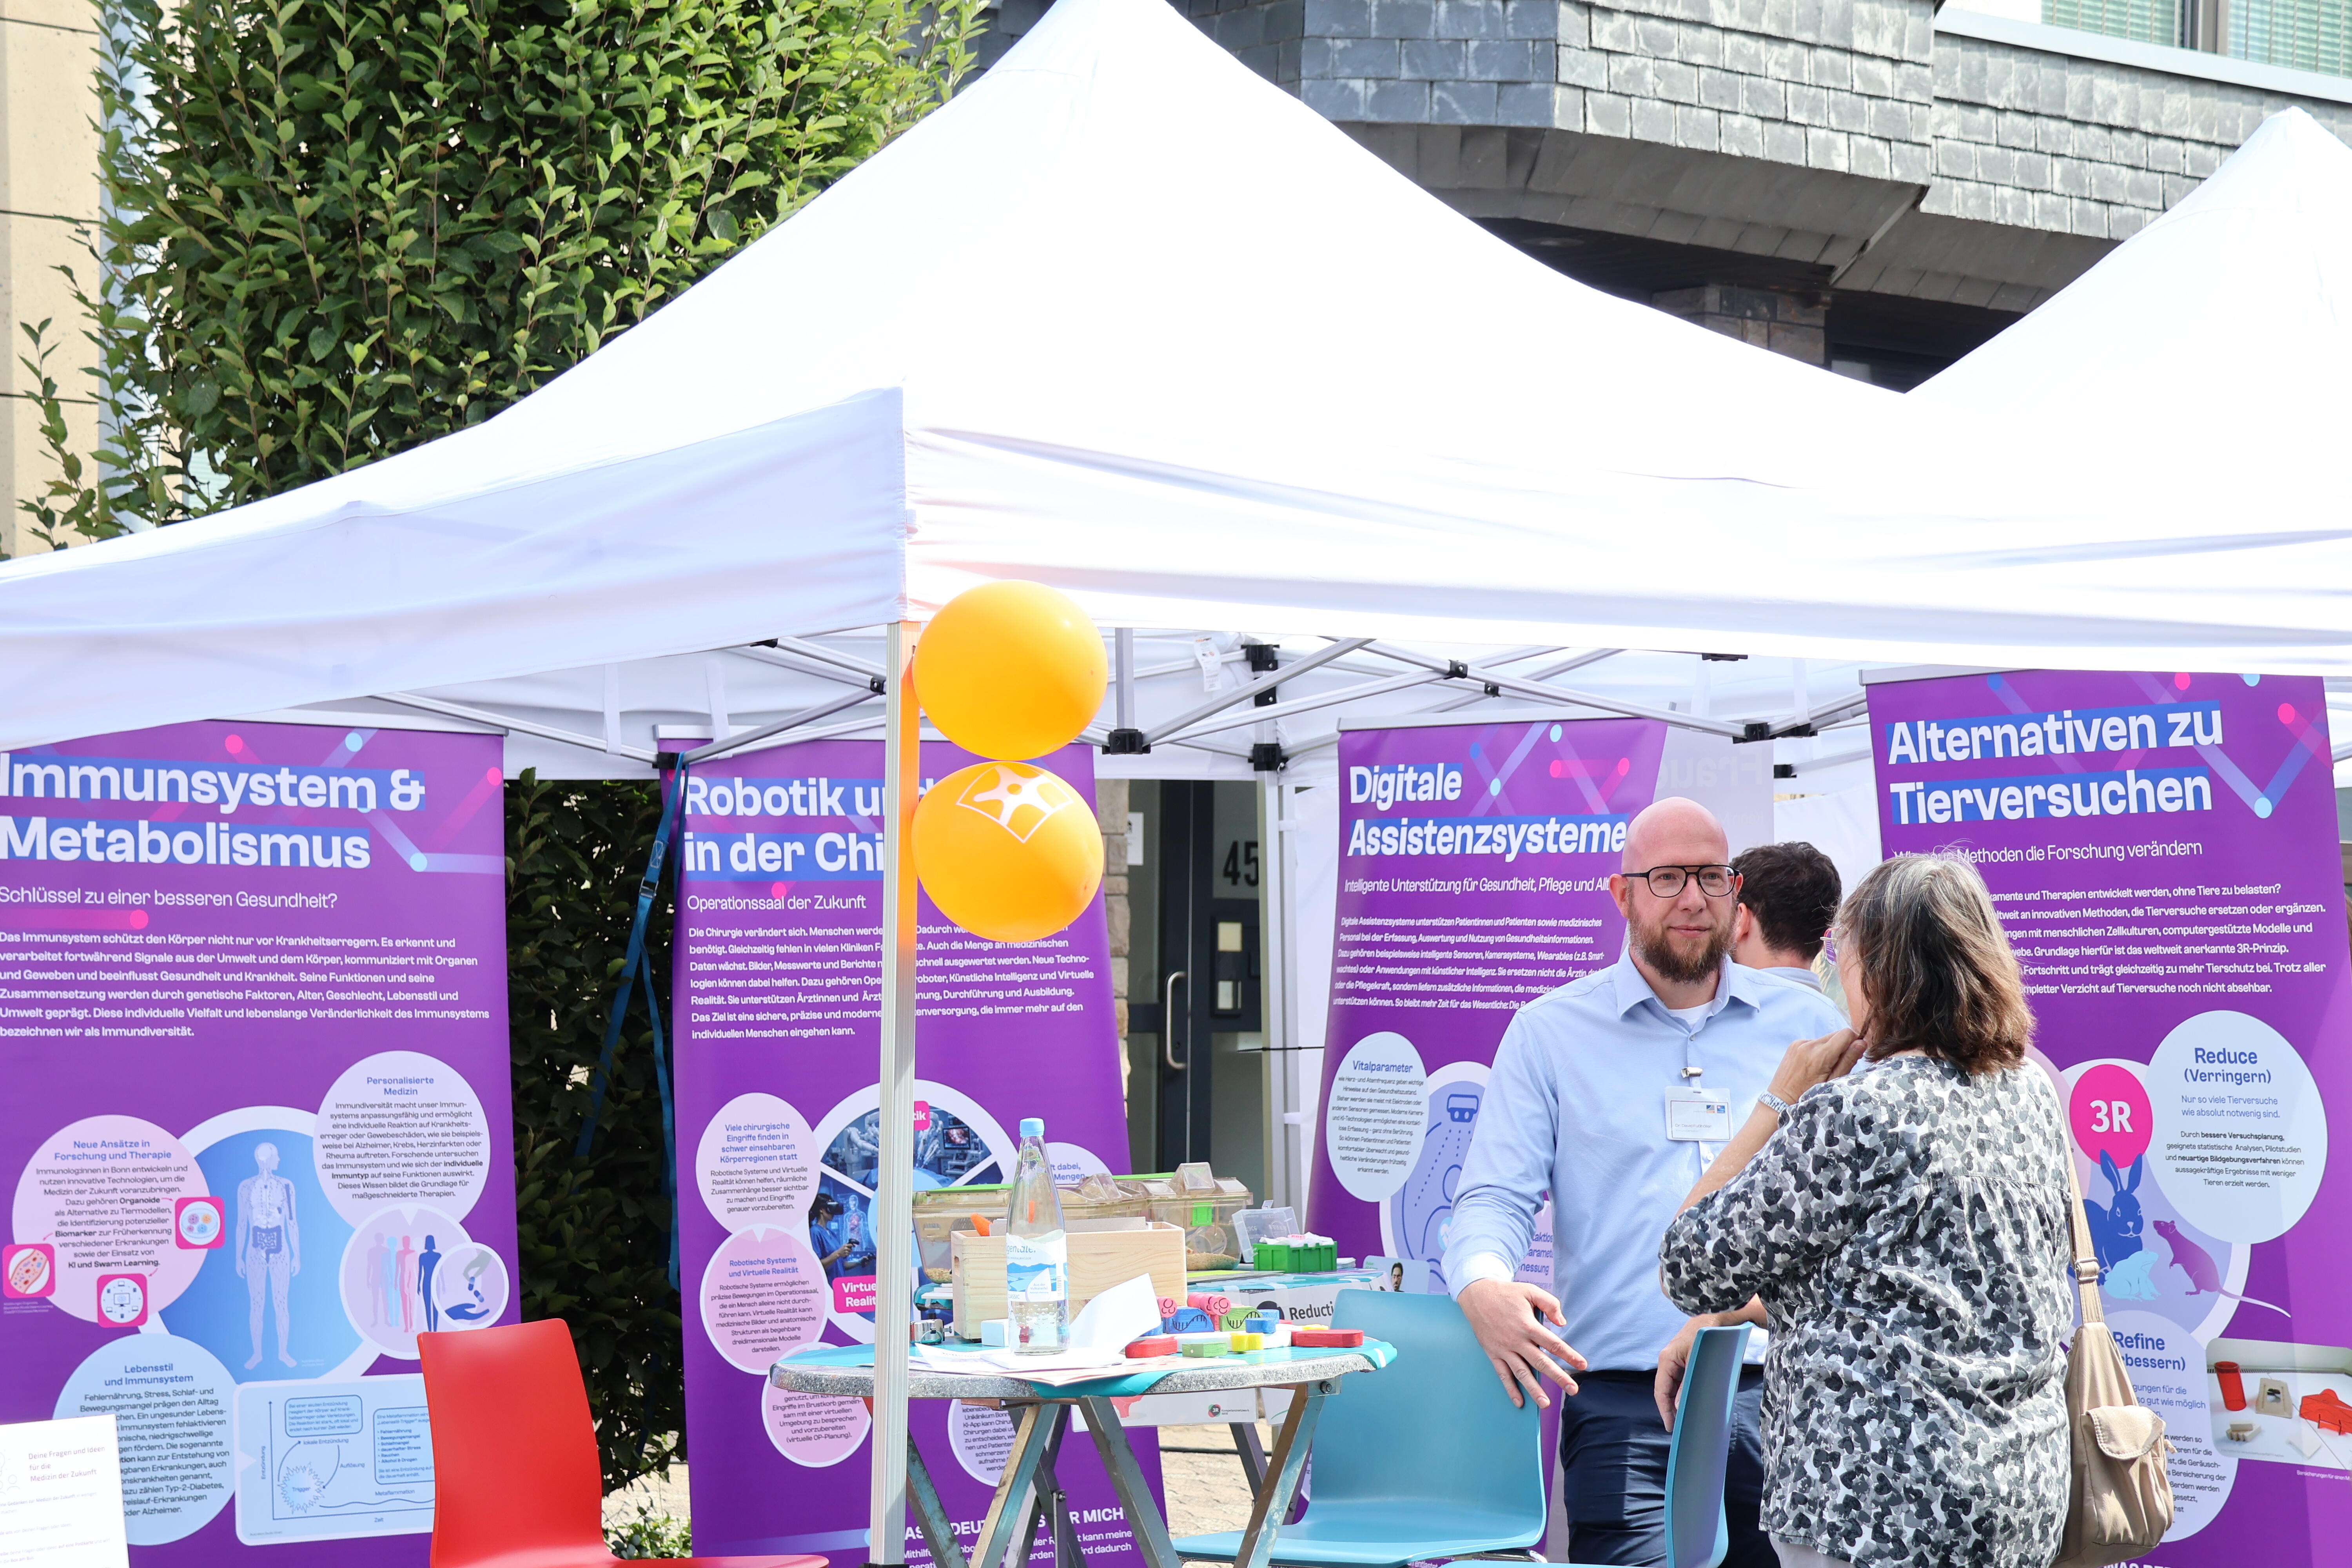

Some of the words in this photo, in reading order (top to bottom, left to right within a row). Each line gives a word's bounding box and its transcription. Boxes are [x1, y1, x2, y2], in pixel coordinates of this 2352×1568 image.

[1889, 710, 2156, 764] Alternativen
[2167, 710, 2223, 747] zu
[0, 753, 376, 813] Immunsystem
[389, 769, 426, 811] &
[1350, 763, 1461, 810] Digitale
[681, 776, 845, 817] Robotik
[1890, 770, 2211, 824] Tierversuchen
[0, 817, 370, 868] Metabolismus
[1348, 818, 1626, 862] Assistenzsysteme
[684, 831, 720, 871] in
[729, 833, 805, 872] der
[815, 832, 884, 872] Chi
[1957, 847, 2024, 863] Methoden
[2025, 845, 2045, 861] die
[2047, 843, 2125, 862] Forschung
[2126, 839, 2203, 857] verändern
[1223, 840, 1259, 887] 45
[1344, 878, 1390, 895] Intelligente
[1391, 878, 1462, 895] Unterstützung
[1463, 877, 1479, 892] für
[1479, 877, 1537, 893] Gesundheit,
[1538, 877, 1573, 895] Pflege
[1573, 877, 1595, 892] und
[0, 886, 81, 904] Schlüssel
[84, 891, 104, 904] zu
[107, 888, 151, 905] einer
[154, 889, 232, 907] besseren
[236, 891, 338, 909] Gesundheit?
[687, 895, 785, 913] Operationssaal
[787, 895, 811, 910] der
[814, 894, 867, 909] Zukunft
[688, 927, 705, 937] Die
[705, 927, 743, 939] Chirurgie
[744, 927, 787, 937] verändert
[788, 927, 808, 936] sich.
[809, 926, 853, 936] Menschen
[0, 931, 21, 942] Das
[22, 931, 101, 945] Immunsystem
[103, 933, 144, 944] schützt
[145, 933, 166, 944] den
[168, 933, 207, 946] Körper
[208, 934, 234, 945] nicht
[236, 936, 254, 945] nur
[256, 937, 274, 946] vor
[276, 935, 380, 949] Krankheitserregern.
[381, 937, 394, 947] Es
[395, 937, 435, 947] erkennt
[436, 937, 456, 948] und
[2034, 946, 2080, 958] Grundlage
[2081, 945, 2113, 956] hierfür
[2114, 945, 2126, 955] ist
[2126, 945, 2143, 955] das
[2143, 944, 2183, 955] weltweit
[2183, 944, 2236, 954] anerkannte
[2236, 942, 2289, 955] 3R-Prinzip.
[944, 956, 997, 966] ausgewertet
[997, 955, 1032, 965] werden.
[1032, 955, 1055, 964] Neue
[1054, 955, 1090, 964] Techno-
[949, 973, 994, 982] Künstliche
[994, 971, 1039, 982] Intelligenz
[1039, 971, 1057, 980] und
[1057, 970, 1094, 980] Virtuelle
[943, 989, 1004, 999] Durchführung
[1005, 988, 1022, 997] und
[1023, 987, 1075, 997] Ausbildung.
[0, 1026, 63, 1037] bezeichnen
[64, 1026, 83, 1036] wir
[84, 1026, 100, 1037] als
[102, 1026, 195, 1037] Immundiversität.
[692, 1029, 745, 1039] individuellen
[745, 1028, 789, 1038] Menschen
[789, 1027, 830, 1038] eingehen
[831, 1026, 855, 1036] kann.
[2194, 1047, 2258, 1065] Reduce
[1352, 1060, 1413, 1073] Vitalparameter
[367, 1076, 434, 1085] Personalisierte
[2184, 1068, 2271, 1086] (Verringern)
[2181, 1095, 2196, 1103] Nur
[2208, 1095, 2226, 1104] viele
[2227, 1096, 2278, 1105] Tierversuche
[2089, 1100, 2133, 1133] 3R
[2181, 1108, 2195, 1116] wie
[2196, 1108, 2225, 1117] absolut
[2226, 1109, 2261, 1120] notwenig
[2262, 1109, 2280, 1118] sind.
[743, 1122, 790, 1132] chirurgische
[726, 1134, 756, 1143] Eingriffe
[2227, 1132, 2285, 1142] Versuchsplanung,
[73, 1141, 98, 1149] Neue
[100, 1140, 140, 1148] Ansätze
[749, 1143, 795, 1152] einsehbaren
[54, 1152, 107, 1162] Forschung
[109, 1151, 127, 1160] und
[129, 1151, 172, 1160] Therapie
[720, 1154, 778, 1164] Körperregionen
[729, 1258, 766, 1267] Robotische
[742, 1268, 771, 1276] Virtuelle
[771, 1266, 799, 1274] Realität
[841, 1282, 877, 1293] Virtue
[845, 1296, 876, 1307] Realit
[1289, 1301, 1334, 1320] Reducti
[2112, 1331, 2165, 1351] Refine
[124, 1363, 173, 1374] Lebensstil
[104, 1377, 123, 1387] und
[125, 1375, 194, 1385] Immunsystem
[84, 1393, 143, 1401] Fehlernährung,
[172, 1388, 198, 1397] Schlaf-
[30, 1474, 57, 1482] Medizin
[71, 1468, 96, 1477] Zukunft
[1083, 1507, 1125, 1523] MICH
[1082, 1532, 1104, 1541] kann
[1105, 1530, 1132, 1539] meine
[1094, 1543, 1132, 1554] dadurch
